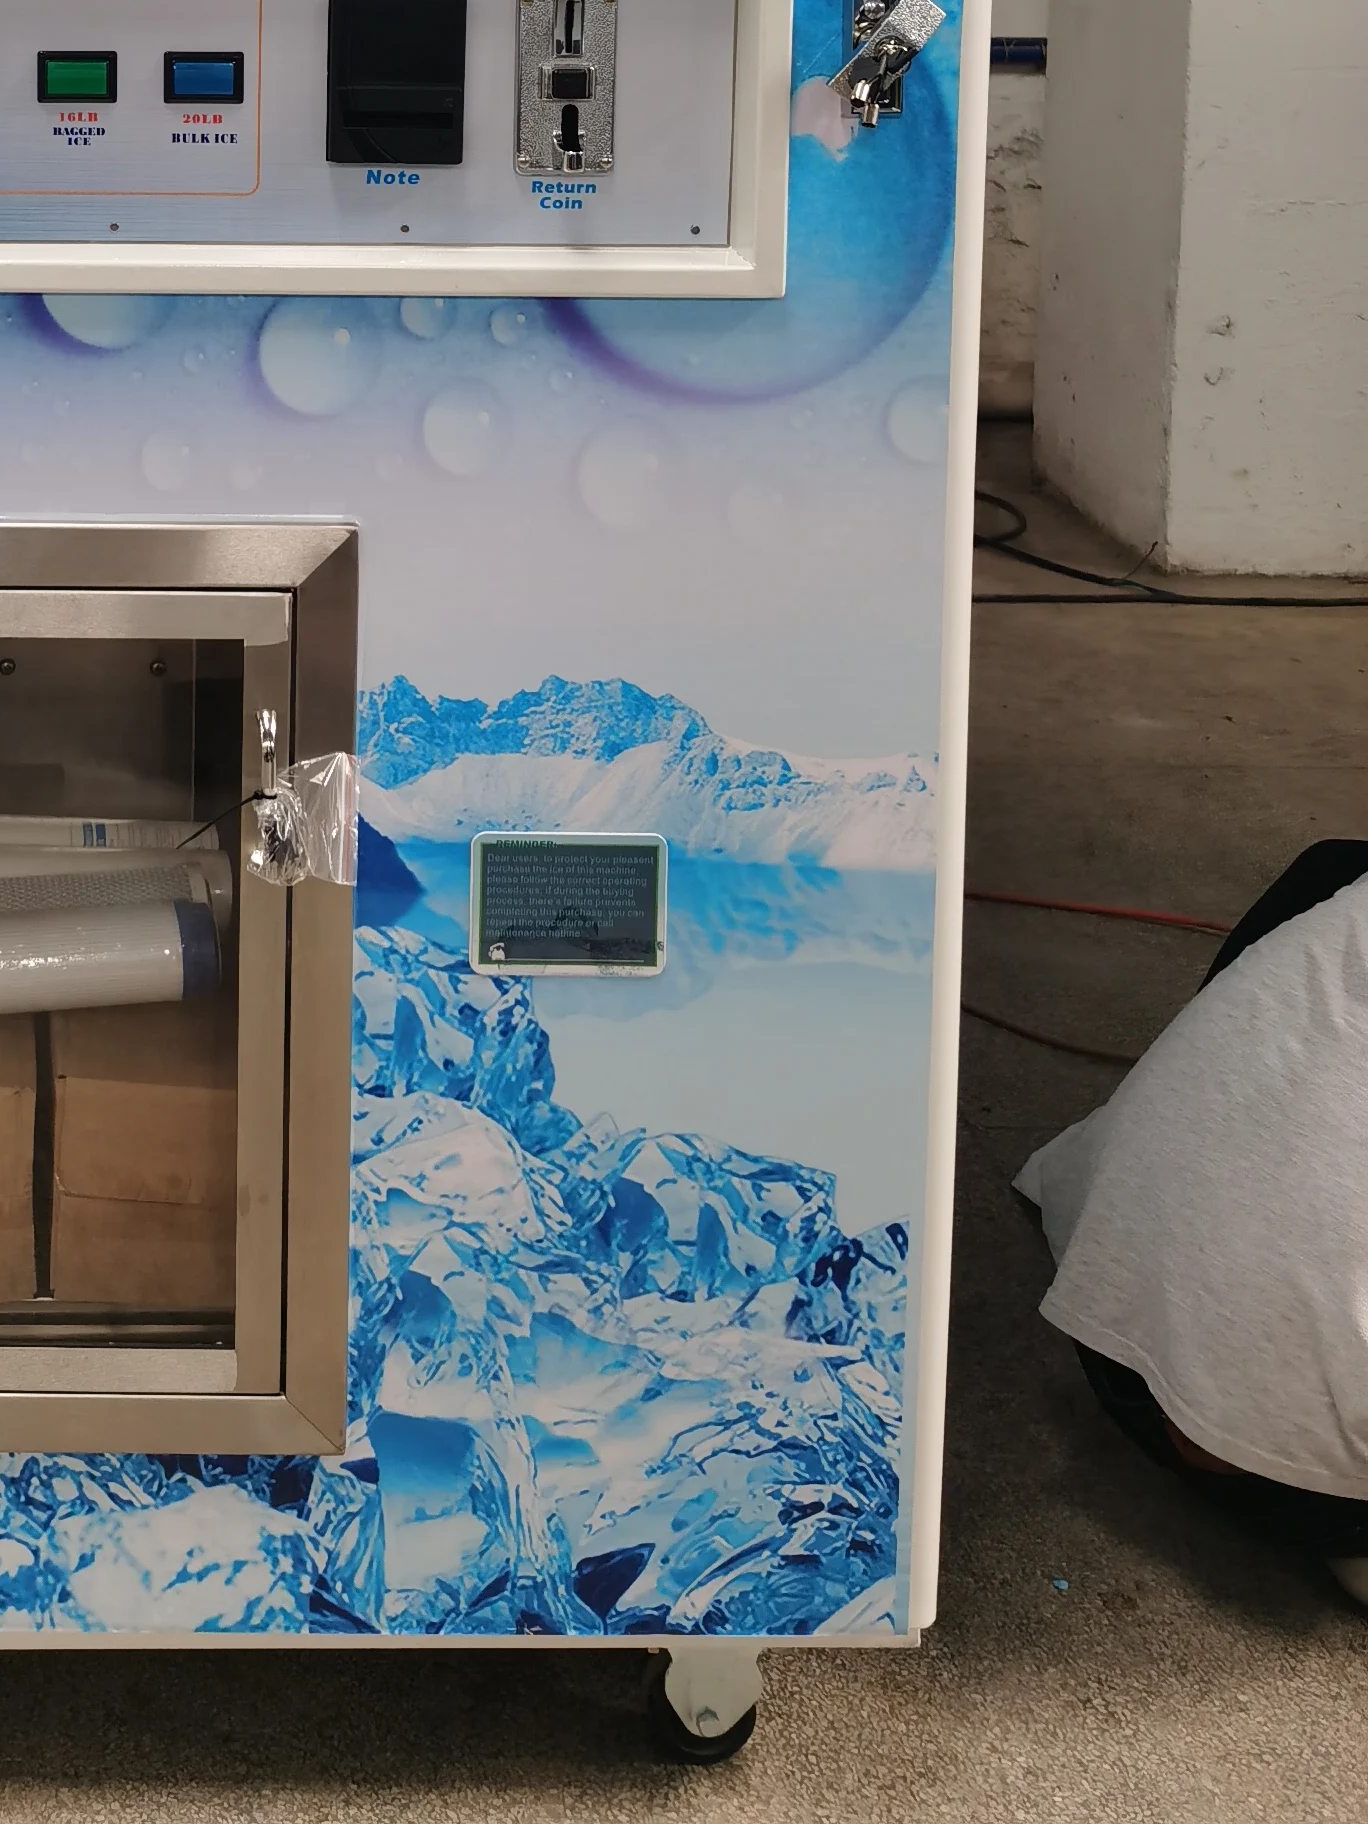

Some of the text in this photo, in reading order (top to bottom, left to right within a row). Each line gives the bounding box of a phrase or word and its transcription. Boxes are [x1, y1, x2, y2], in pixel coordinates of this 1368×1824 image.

[59, 112, 98, 122] 16LB
[183, 114, 223, 124] 20LB
[53, 127, 105, 136] BAGGED
[67, 136, 91, 146] ICE
[171, 133, 238, 144] BULK ICE
[366, 169, 420, 185] Note
[531, 181, 596, 193] Return
[539, 197, 583, 210] Coin
[590, 856, 610, 865] your
[520, 876, 548, 884] follow
[553, 886, 582, 896] during
